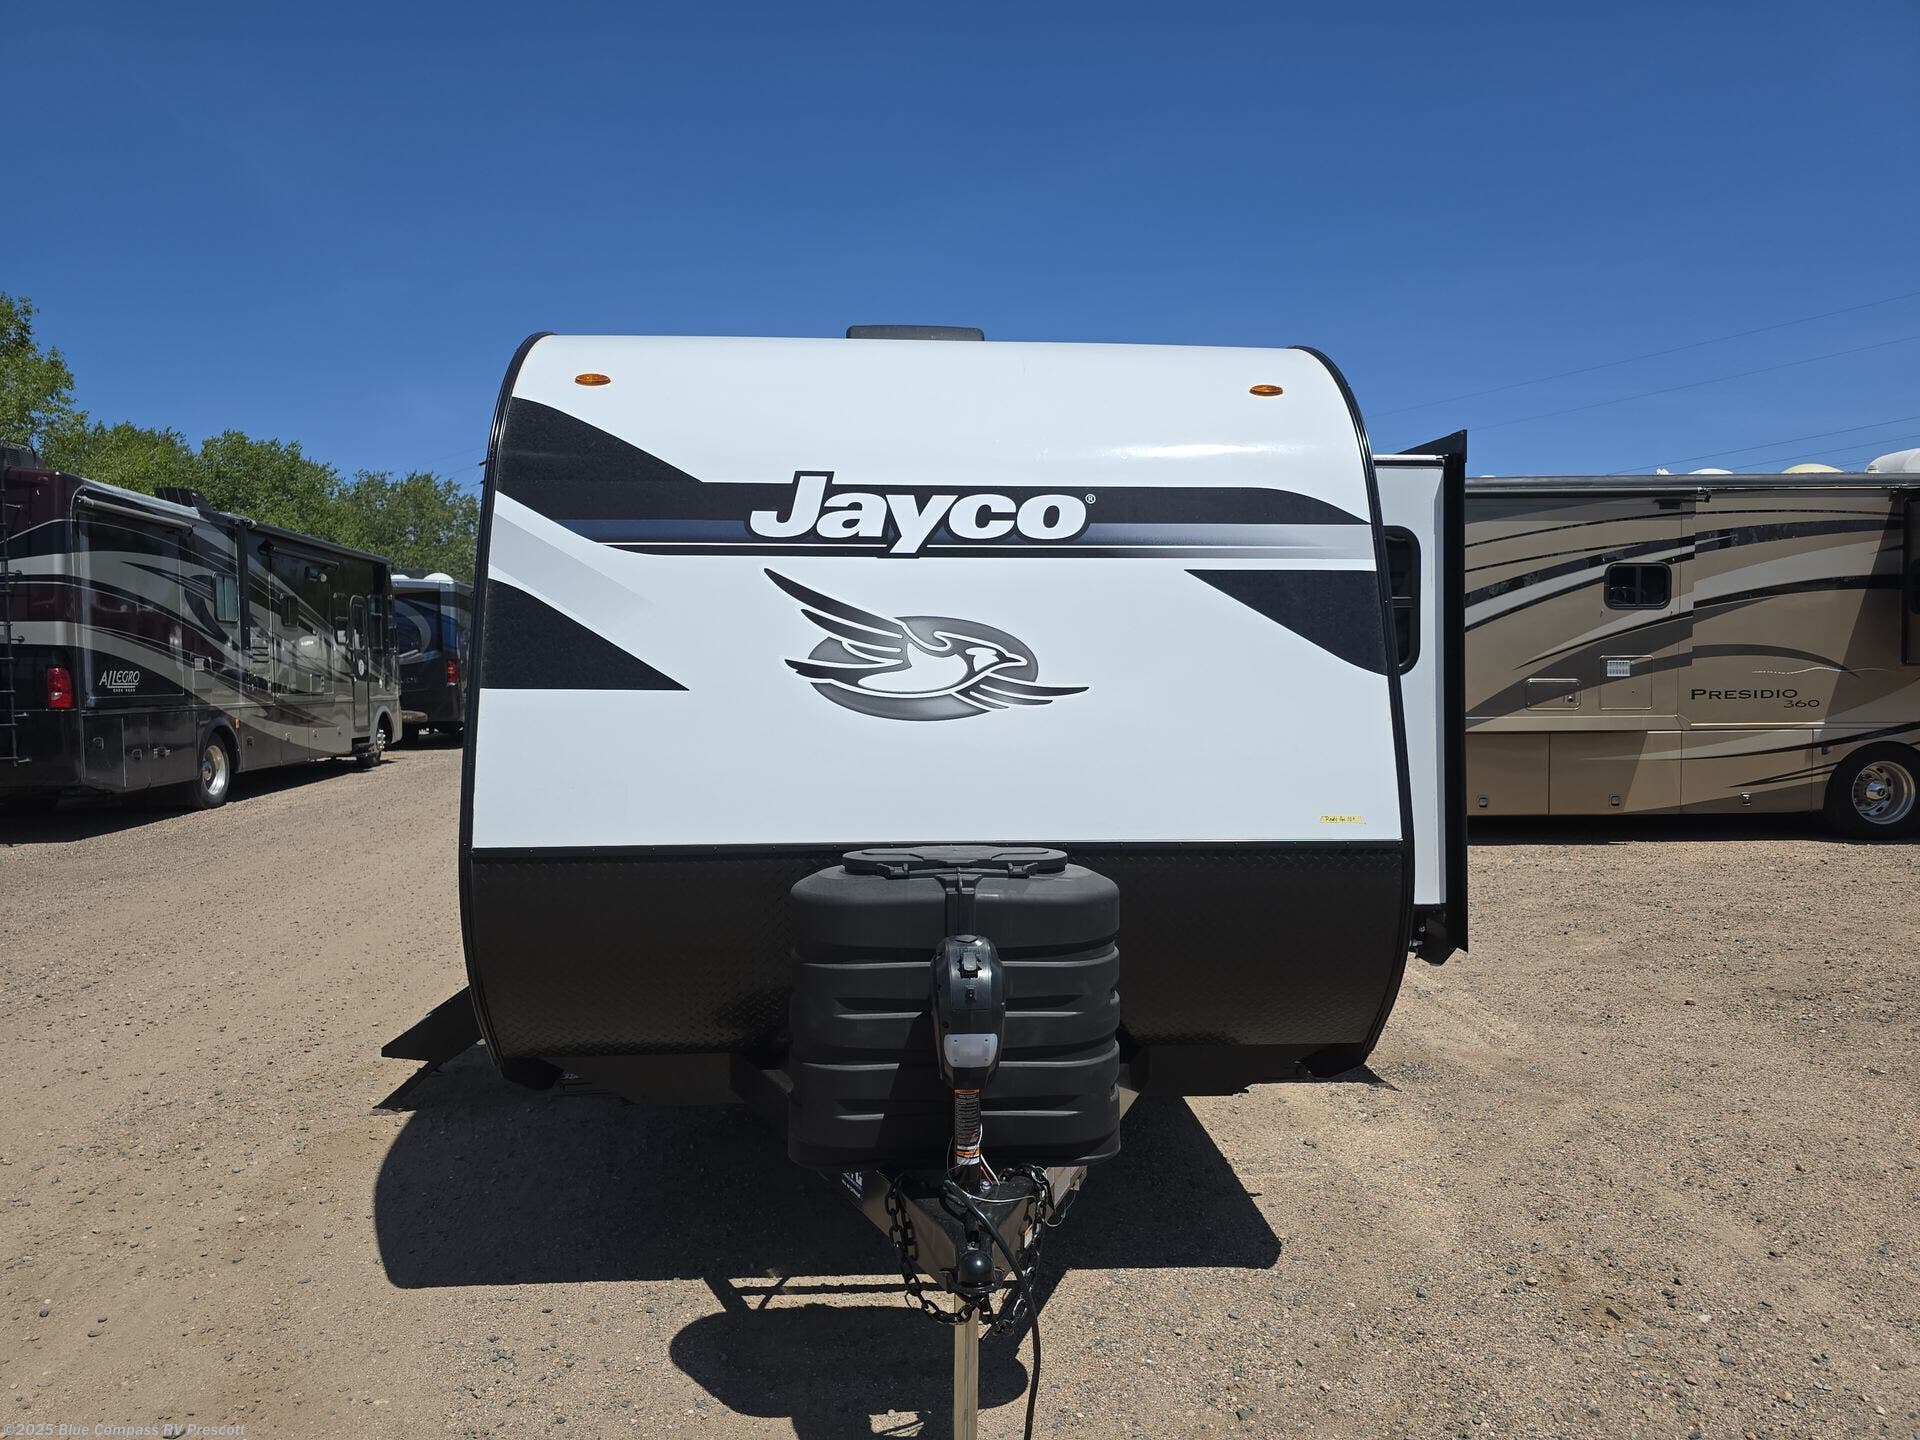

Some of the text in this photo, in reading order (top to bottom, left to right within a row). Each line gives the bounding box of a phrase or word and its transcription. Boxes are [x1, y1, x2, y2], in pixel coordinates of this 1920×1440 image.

[99, 670, 140, 688] ALLEGRO
[1690, 688, 1798, 700] PRESIDIO
[1783, 699, 1820, 708] 360
